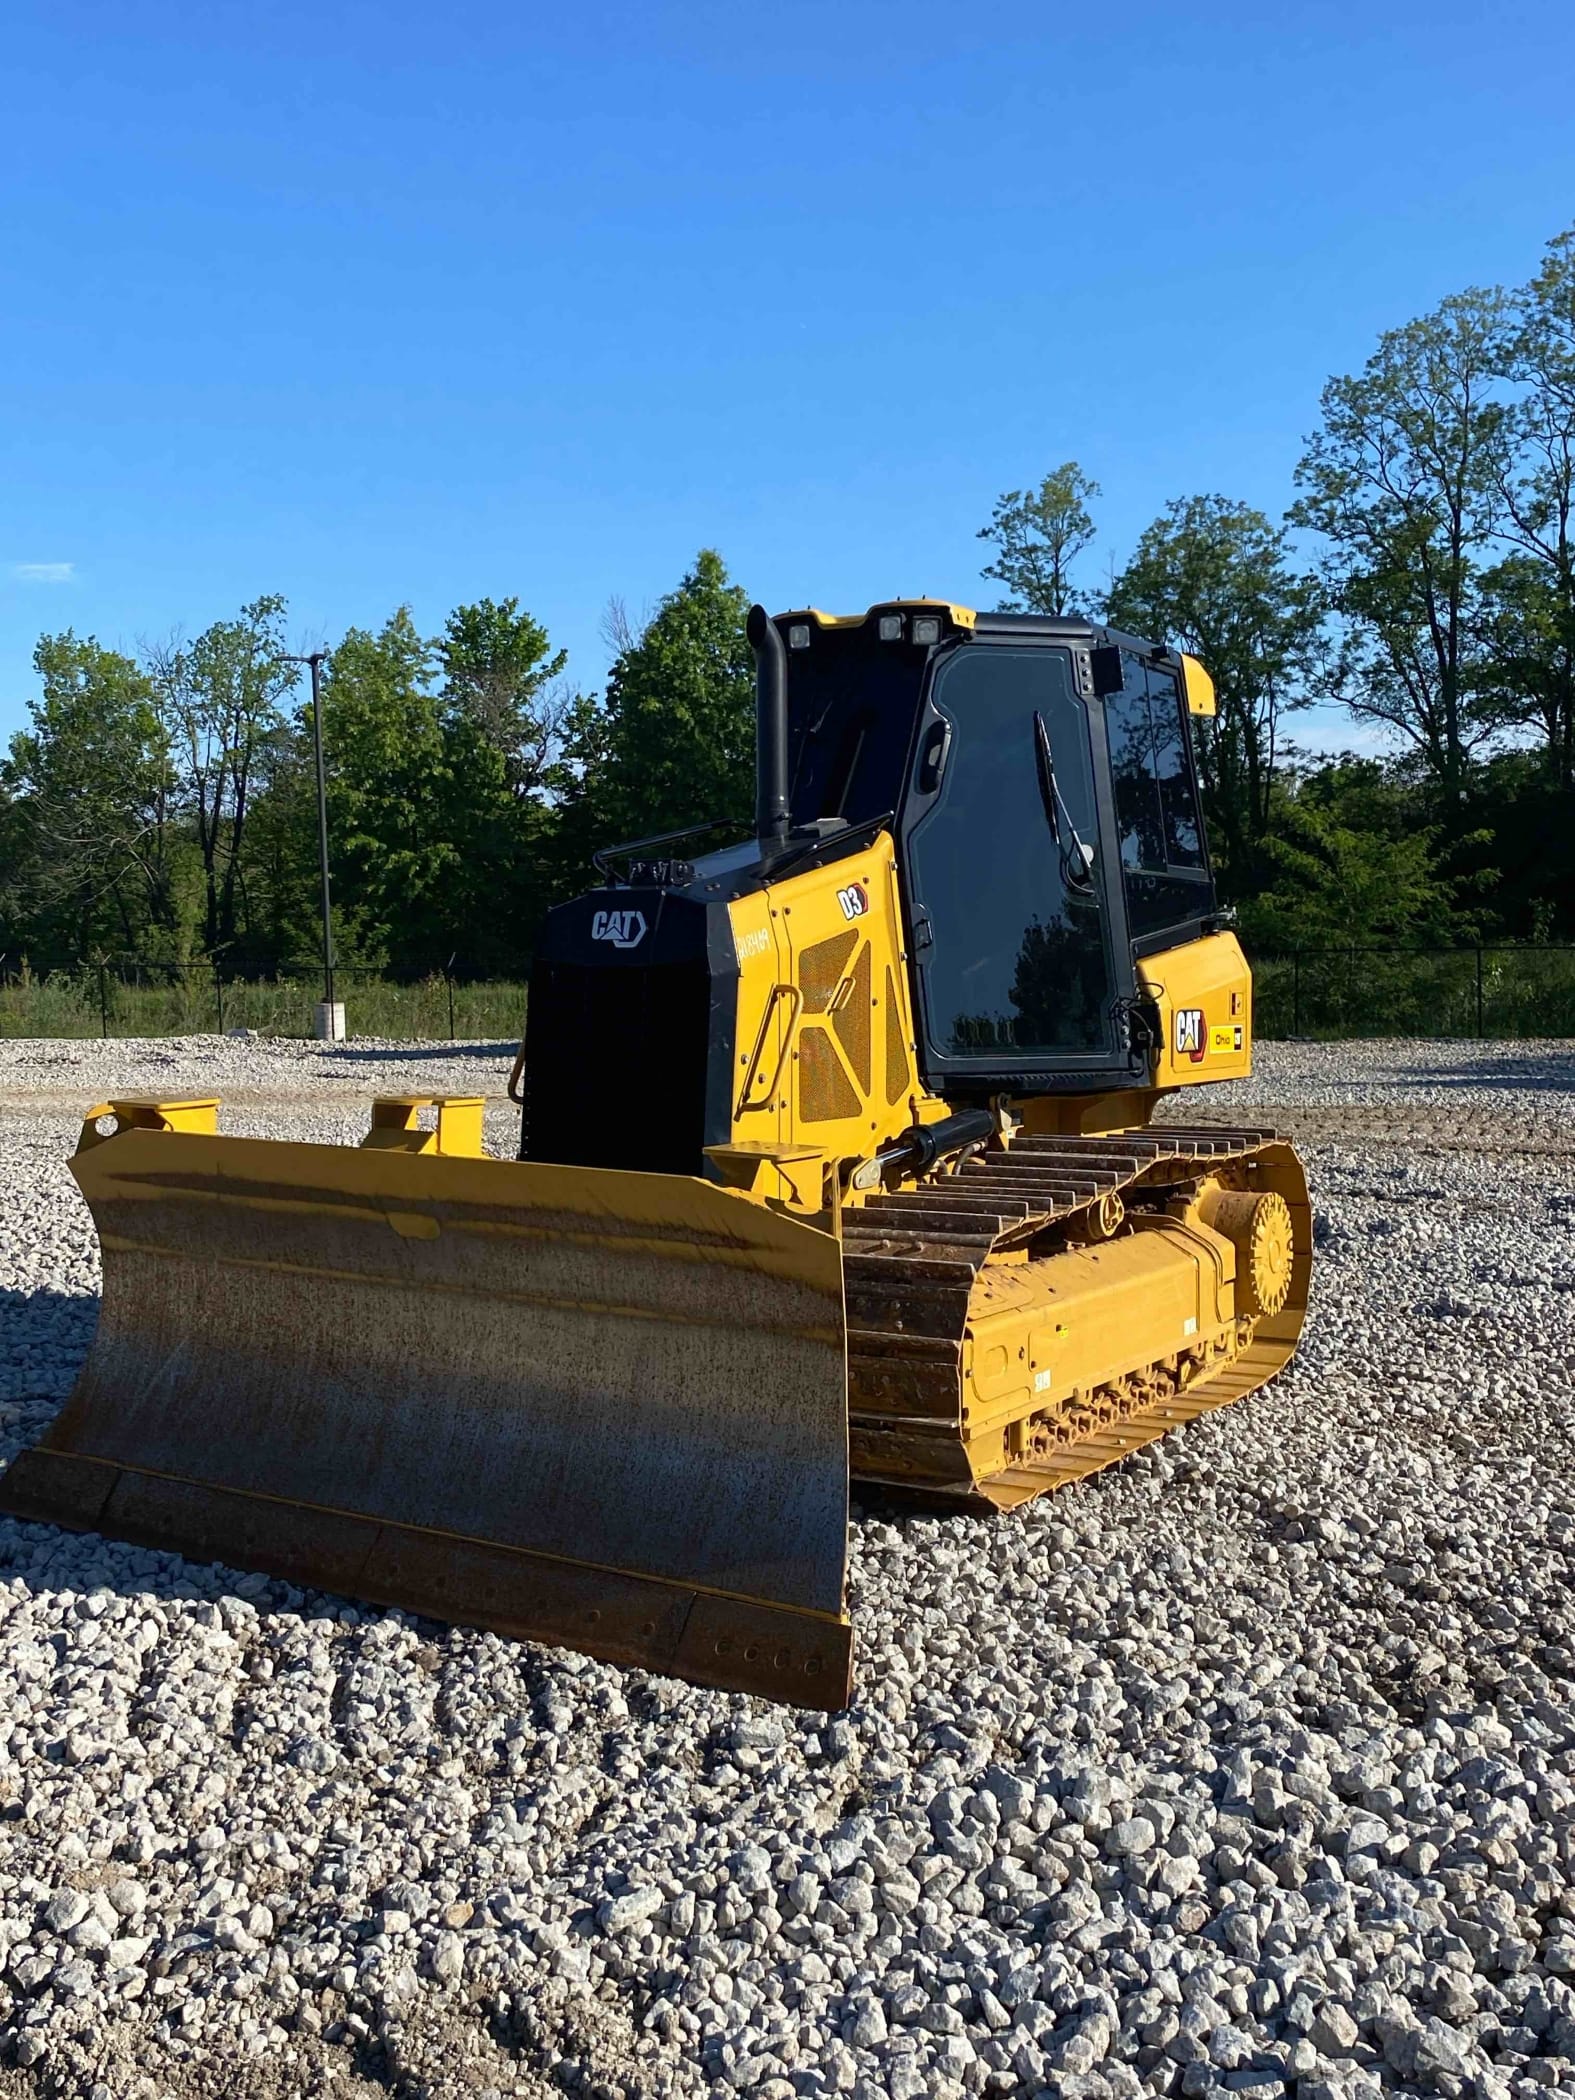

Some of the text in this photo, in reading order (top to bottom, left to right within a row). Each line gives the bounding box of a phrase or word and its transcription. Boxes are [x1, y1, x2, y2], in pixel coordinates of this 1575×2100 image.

[837, 886, 863, 920] D3
[592, 911, 636, 940] CAT
[1176, 1010, 1202, 1052] CAT
